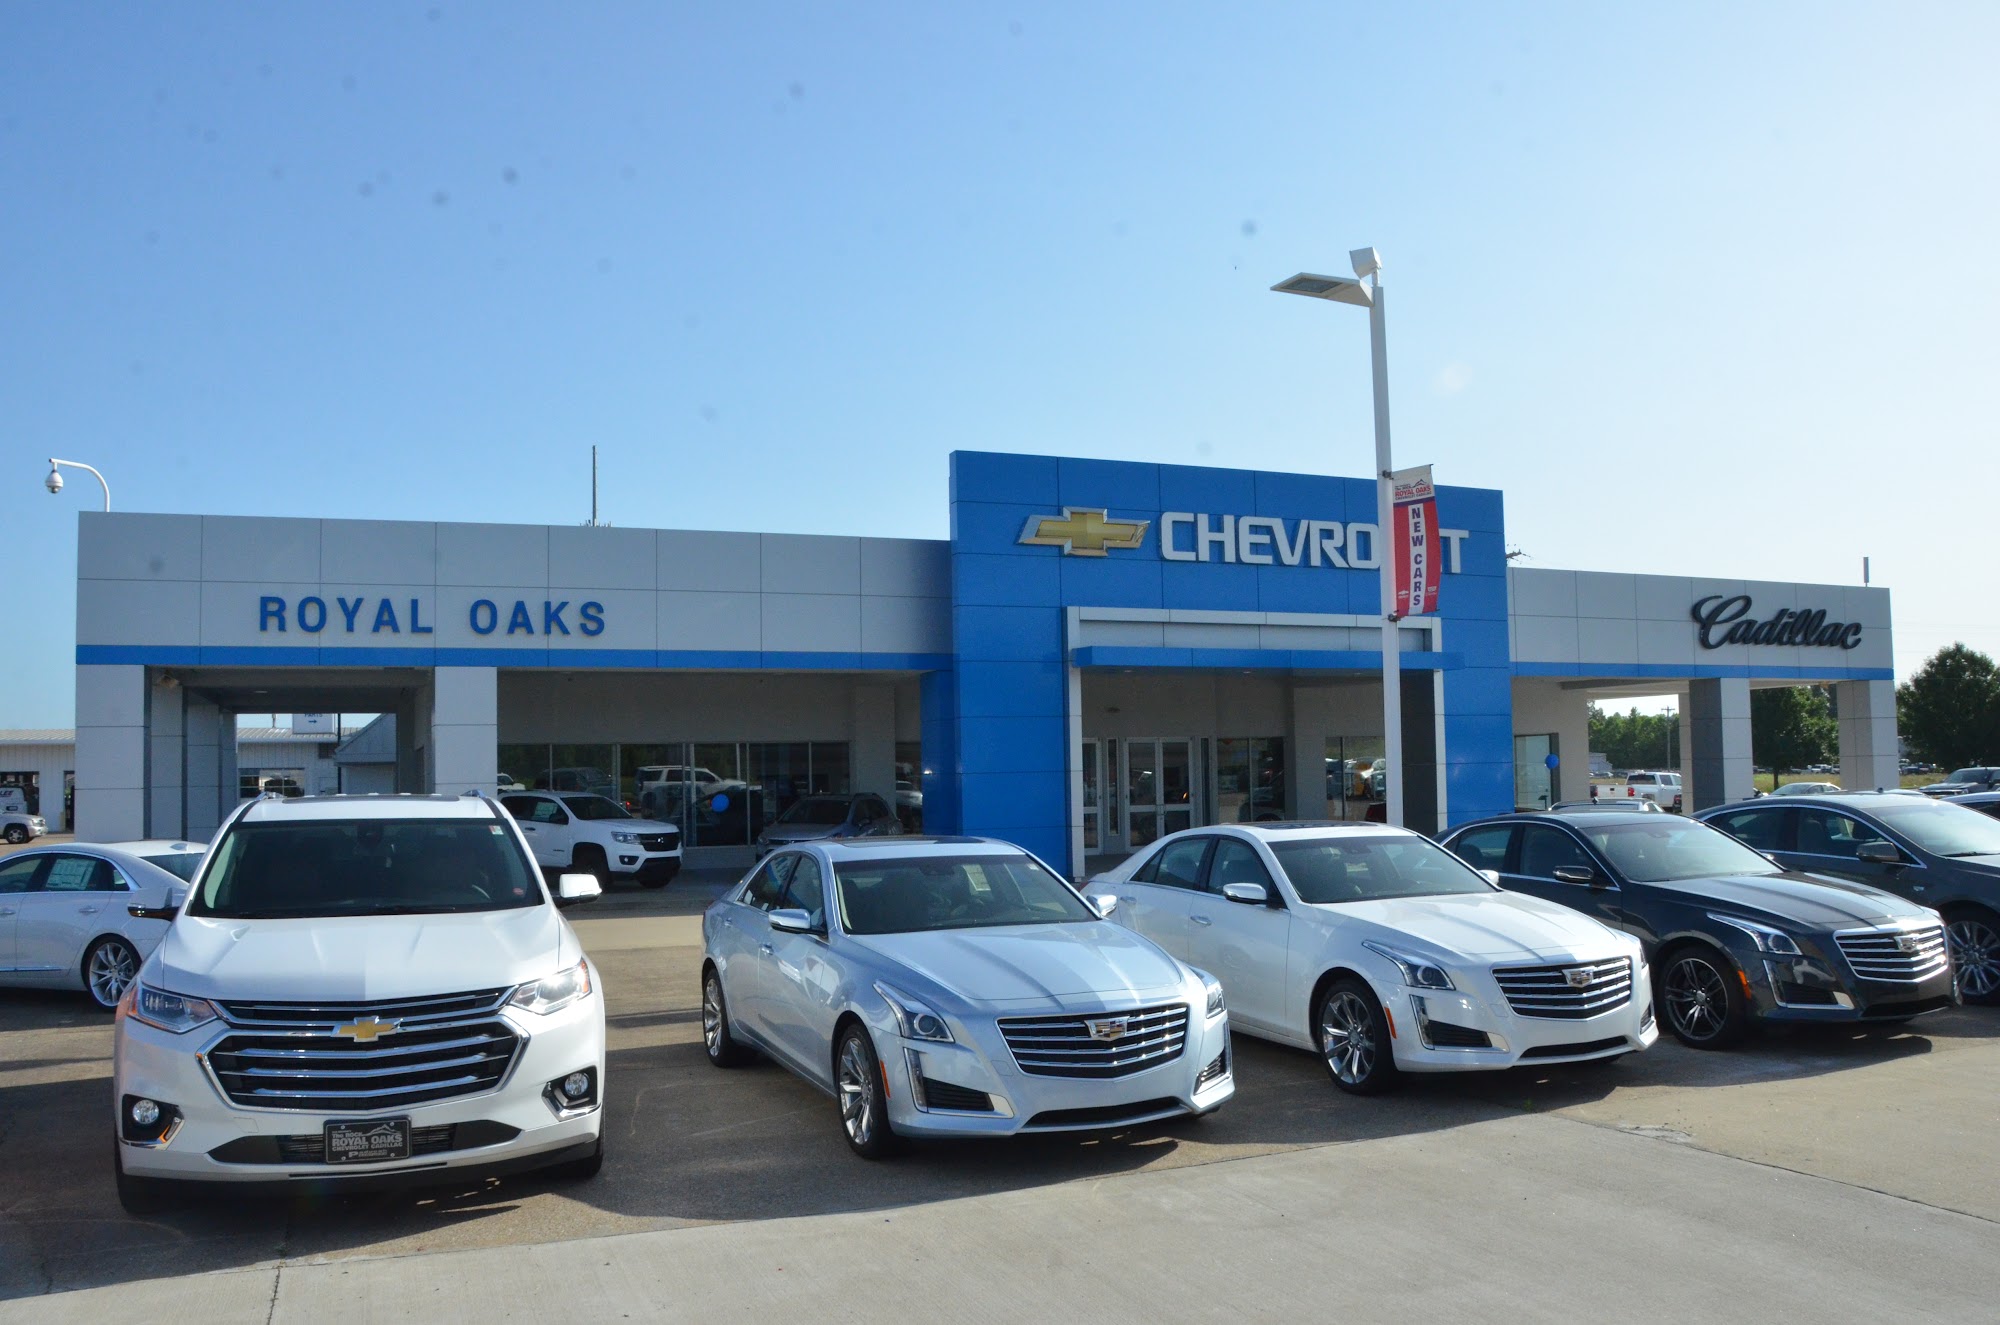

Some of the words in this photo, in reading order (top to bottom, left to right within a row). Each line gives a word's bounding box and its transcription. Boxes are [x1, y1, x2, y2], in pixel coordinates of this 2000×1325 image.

[1394, 488, 1415, 497] ROYAL
[1416, 485, 1432, 493] OAKS
[1161, 511, 1469, 573] CHEVROT
[1411, 507, 1424, 547] NEW
[1413, 553, 1423, 606] CARS
[259, 596, 433, 634] ROYAL
[470, 599, 605, 636] OAKS
[1691, 595, 1862, 649] Cadillac
[332, 1137, 369, 1147] ROYAL
[371, 1134, 403, 1144] OAKS
[332, 1144, 369, 1152] CHEVROLET
